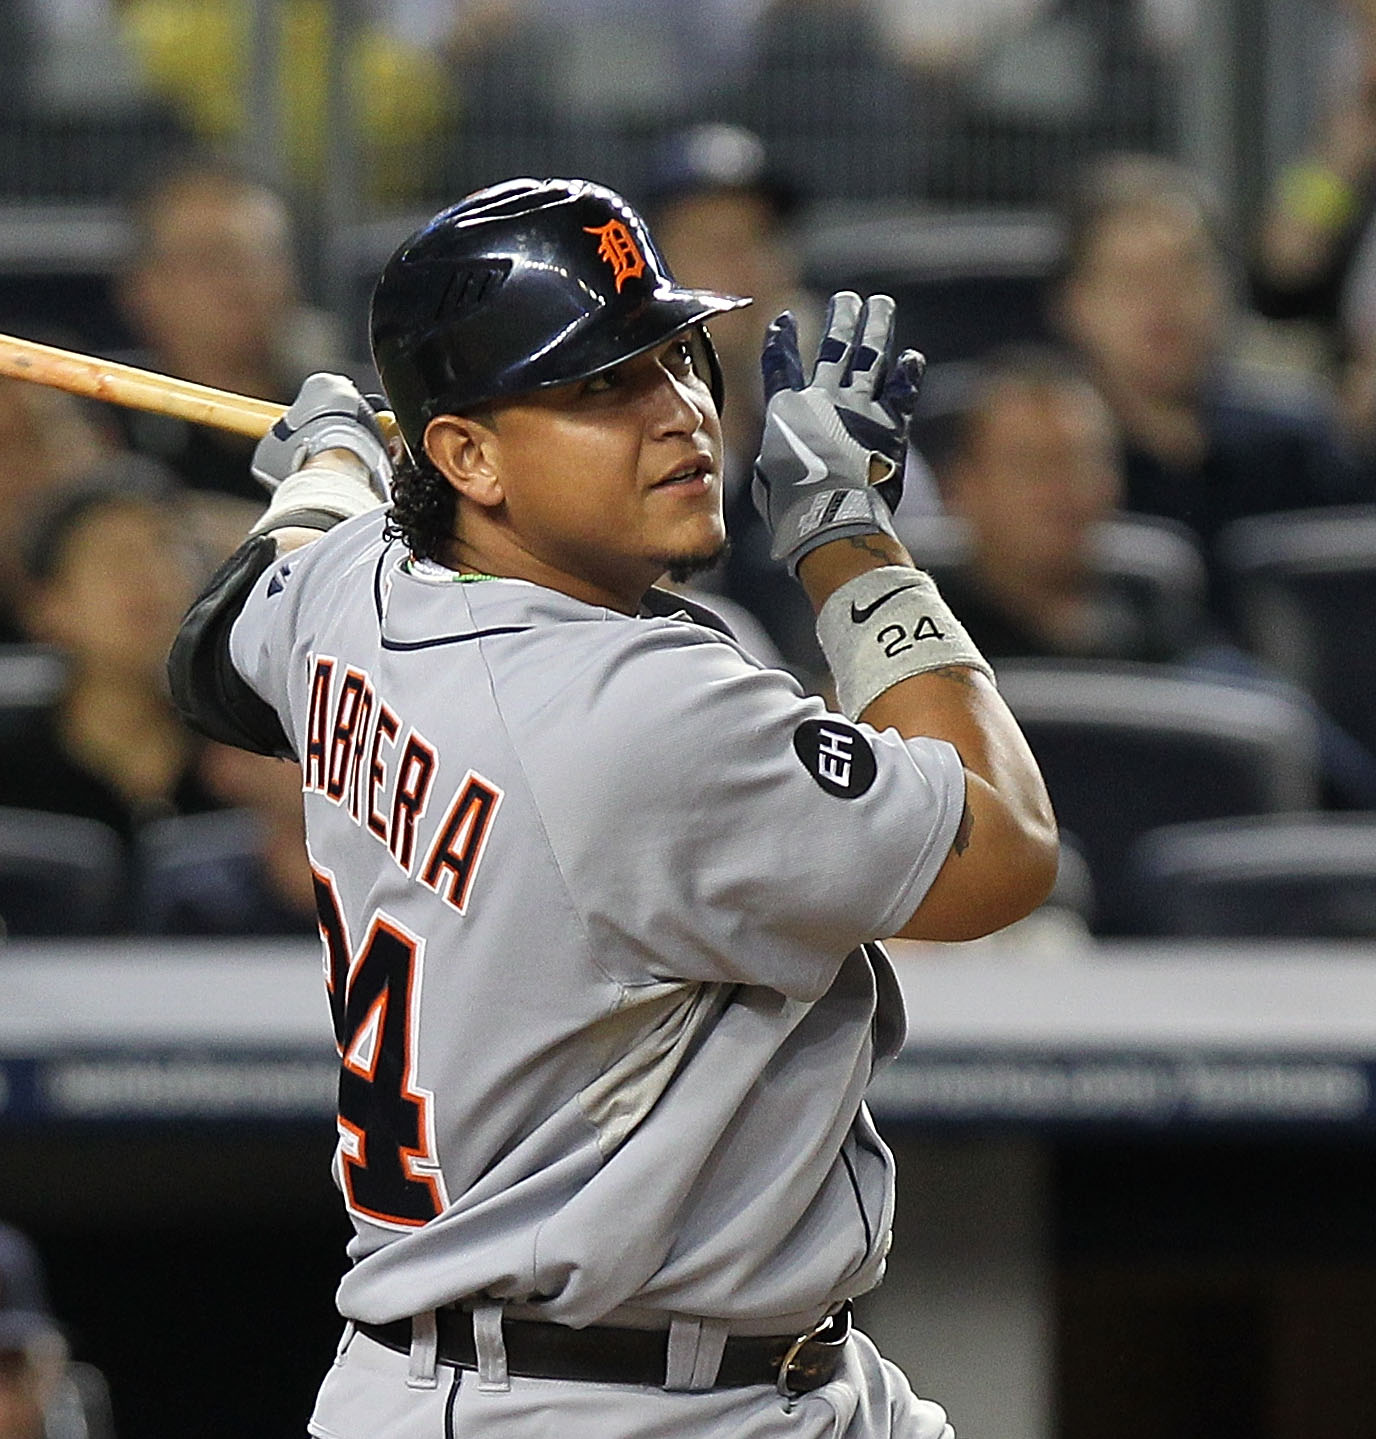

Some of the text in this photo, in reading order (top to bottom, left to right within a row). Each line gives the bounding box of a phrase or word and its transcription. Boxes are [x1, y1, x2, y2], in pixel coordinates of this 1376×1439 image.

[877, 615, 945, 658] 24
[303, 651, 505, 916] ABRERA
[818, 728, 853, 787] EH
